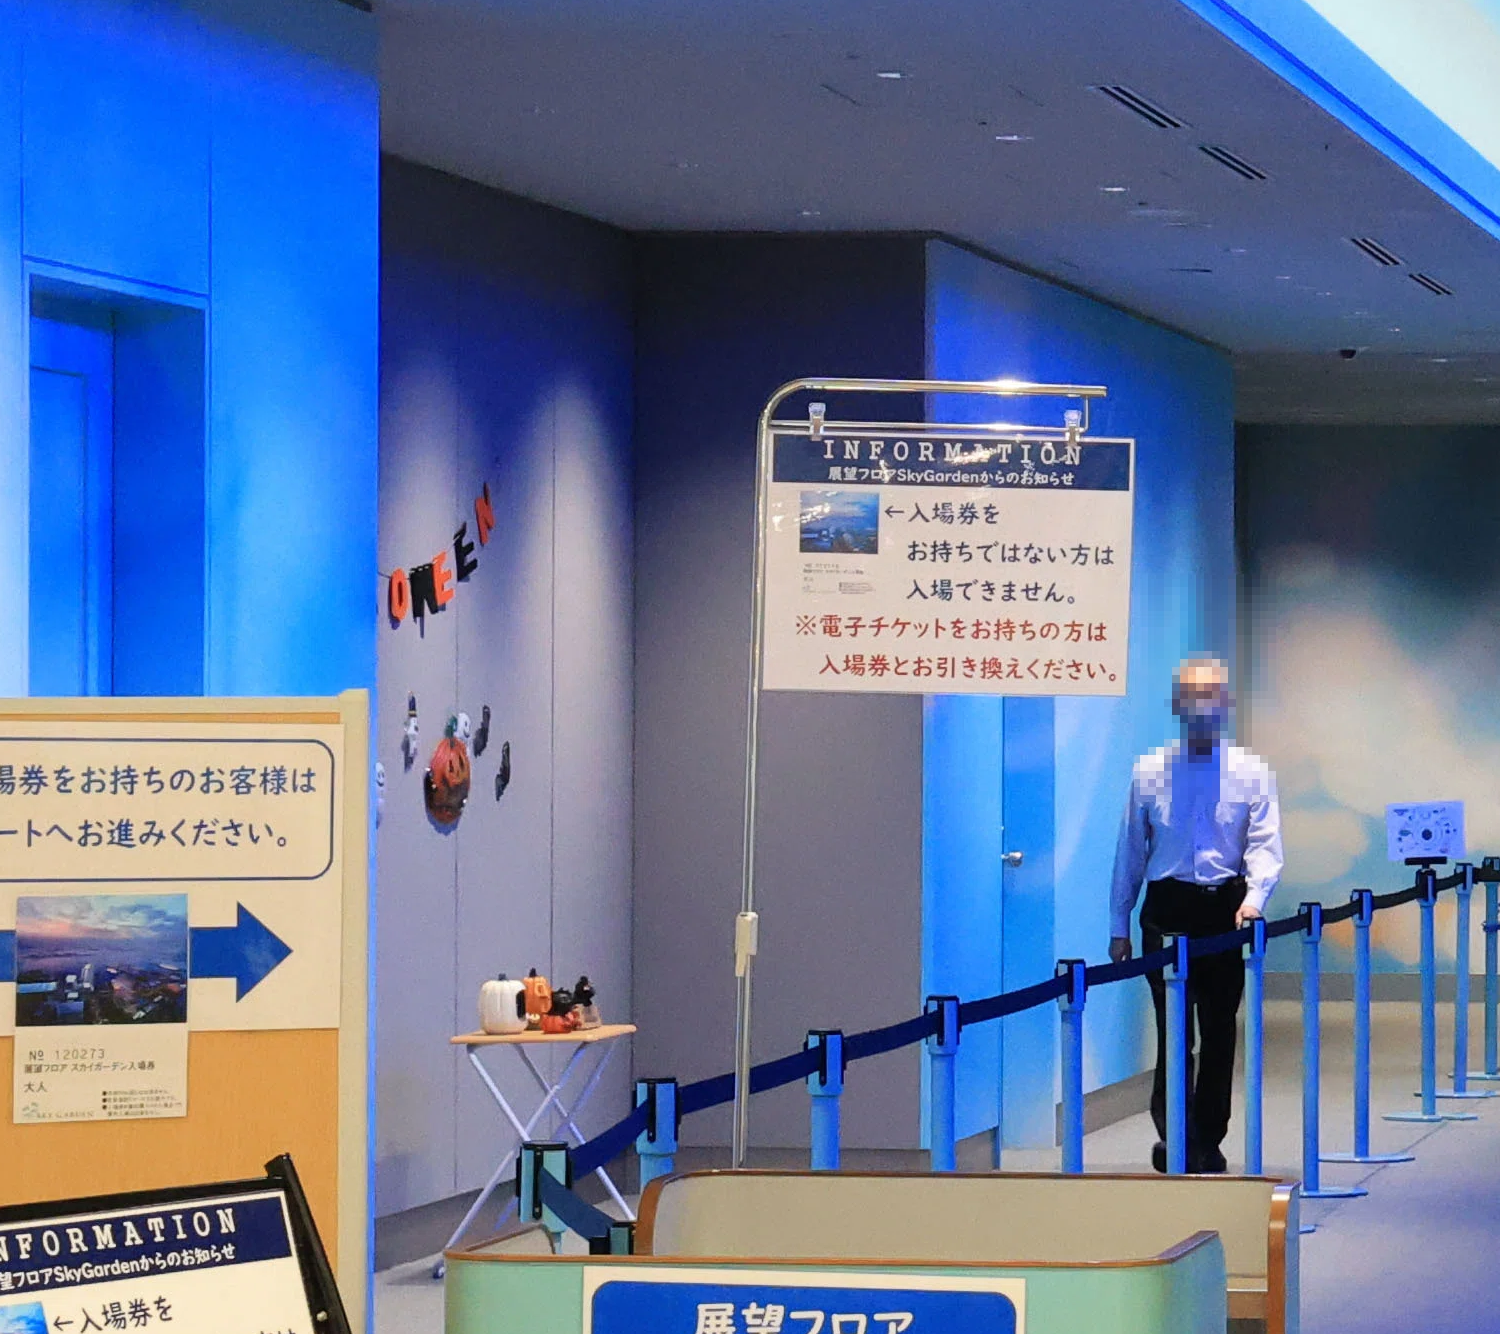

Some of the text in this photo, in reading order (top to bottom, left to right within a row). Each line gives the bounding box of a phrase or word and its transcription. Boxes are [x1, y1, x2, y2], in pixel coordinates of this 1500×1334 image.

[907, 502, 999, 525] 入場券を
[907, 541, 1114, 565] お持ちではない方は
[906, 579, 1076, 604] 入場できません。
[818, 654, 1117, 682] 入場券とお引き換えください。
[24, 1081, 47, 1093] 大人
[79, 1295, 173, 1334] 入場券を
